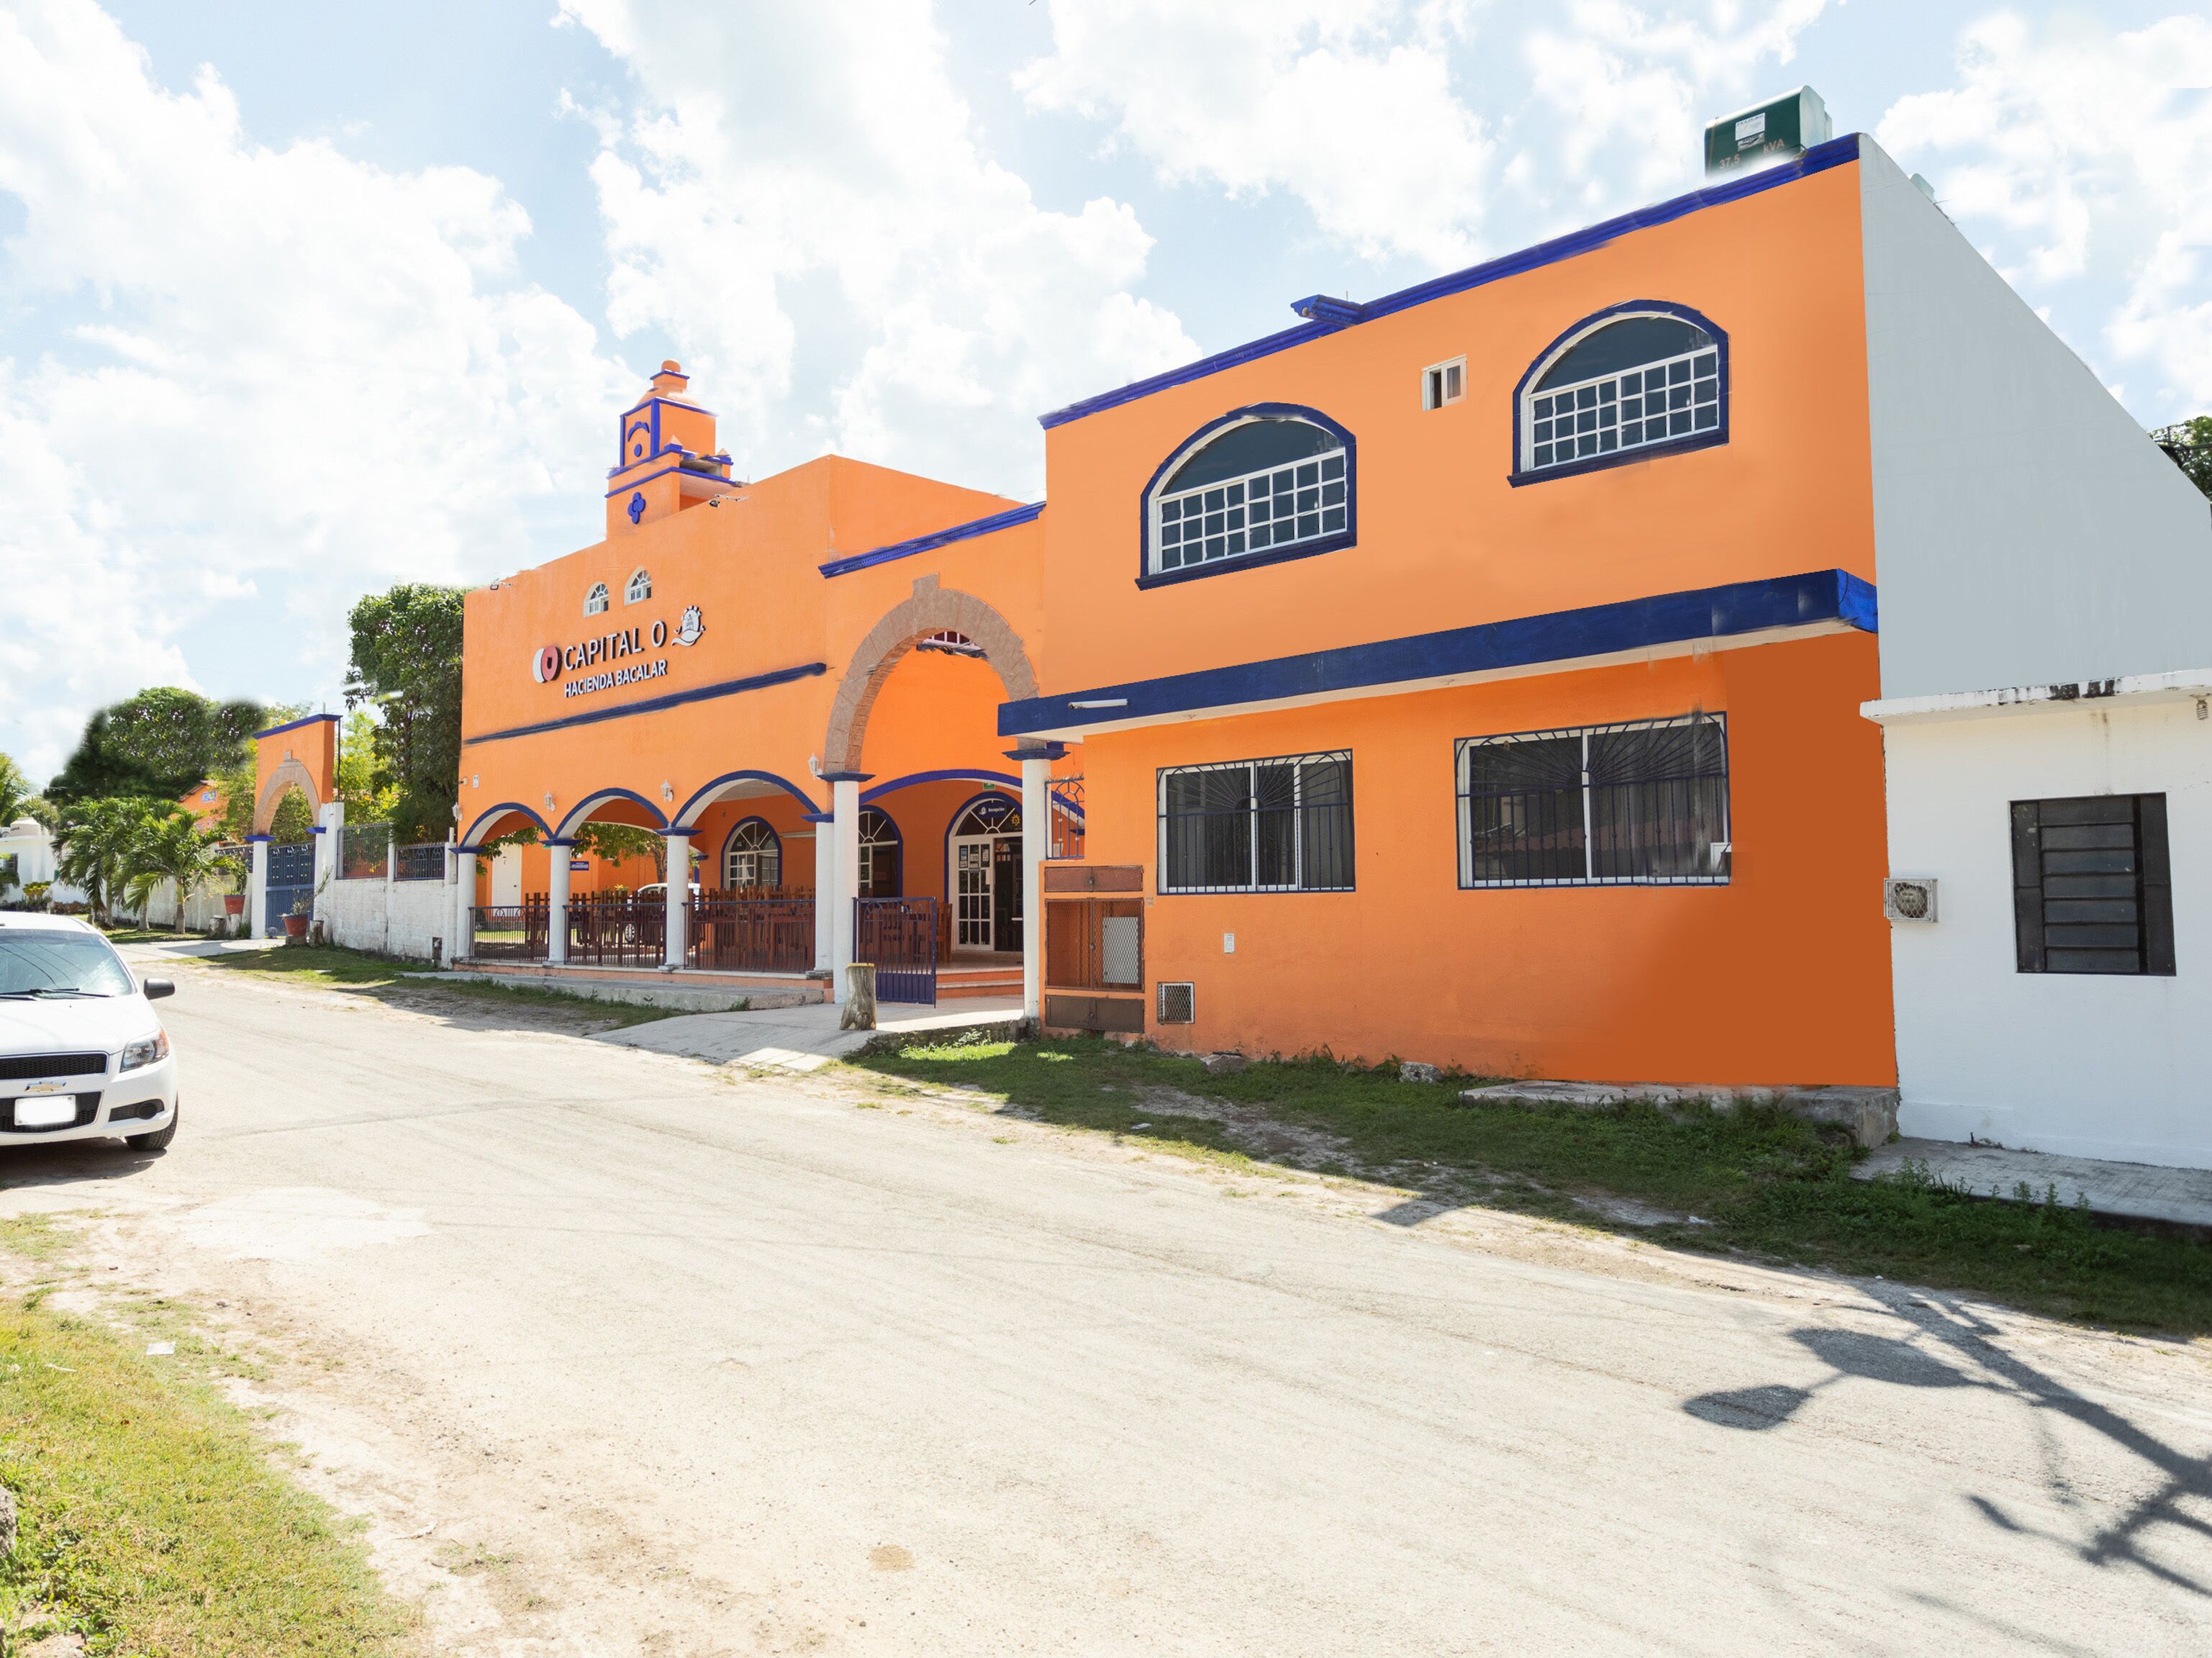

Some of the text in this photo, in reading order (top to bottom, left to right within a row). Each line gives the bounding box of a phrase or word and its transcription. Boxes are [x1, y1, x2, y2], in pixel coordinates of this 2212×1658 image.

[563, 620, 666, 671] CAPITAL O
[564, 658, 667, 698] HACIENDA BACALAR
